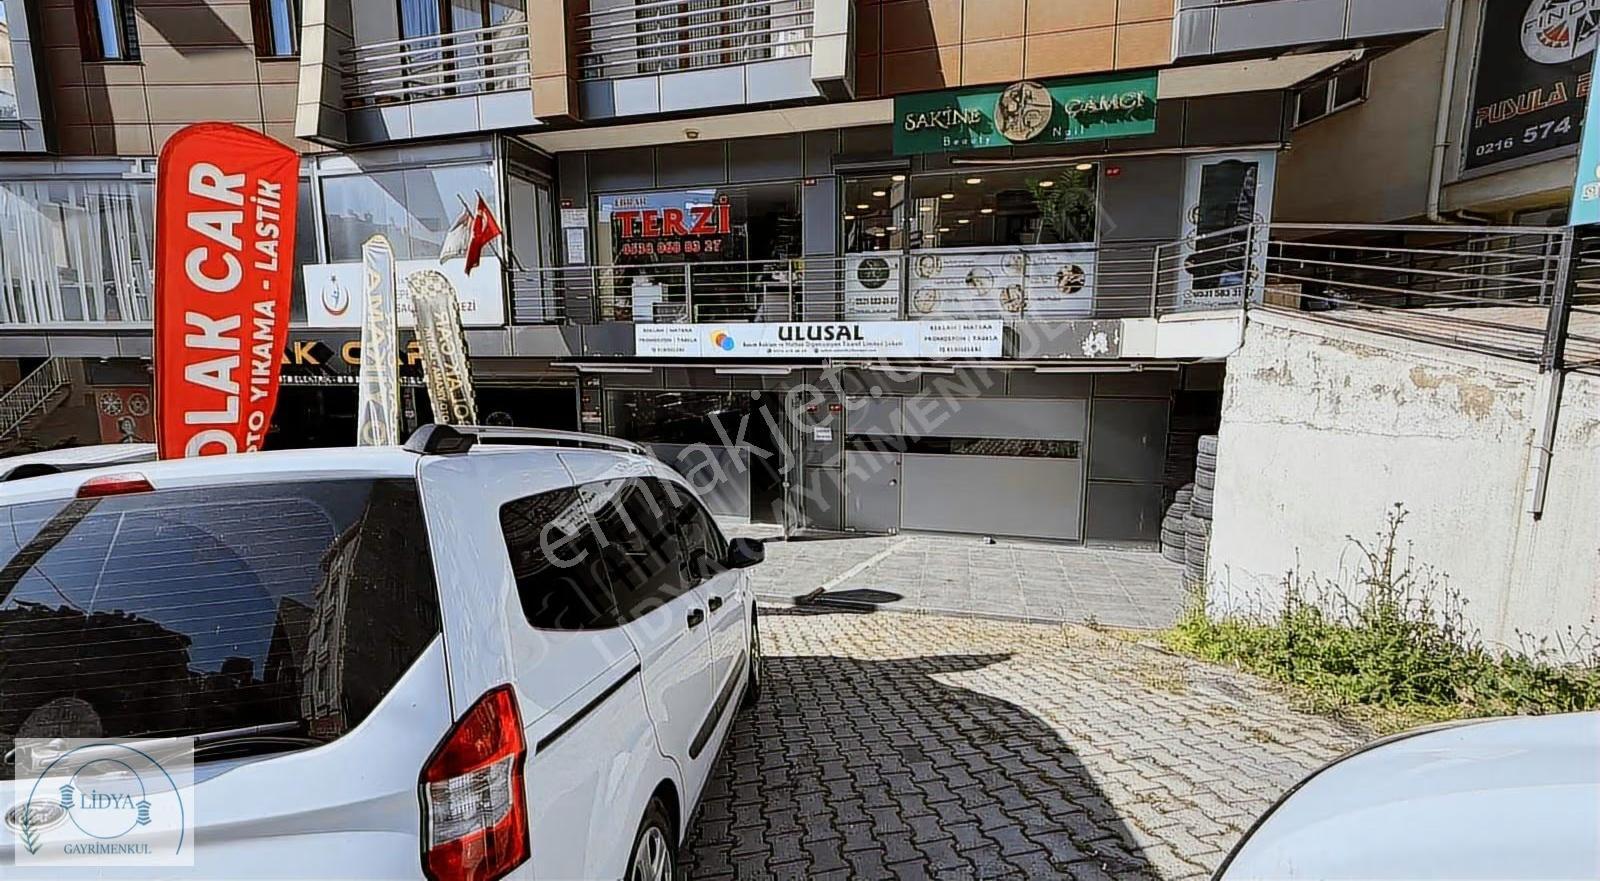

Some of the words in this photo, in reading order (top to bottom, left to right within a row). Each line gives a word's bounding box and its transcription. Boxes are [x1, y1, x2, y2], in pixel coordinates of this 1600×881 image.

[1476, 137, 1513, 156] 0216
[1523, 116, 1571, 143] 574
[185, 162, 246, 293] CAR
[250, 179, 282, 272] LASTİK
[613, 195, 731, 238] TERZİ
[250, 300, 276, 402] YIKAMA
[778, 325, 864, 341] ULUSAL
